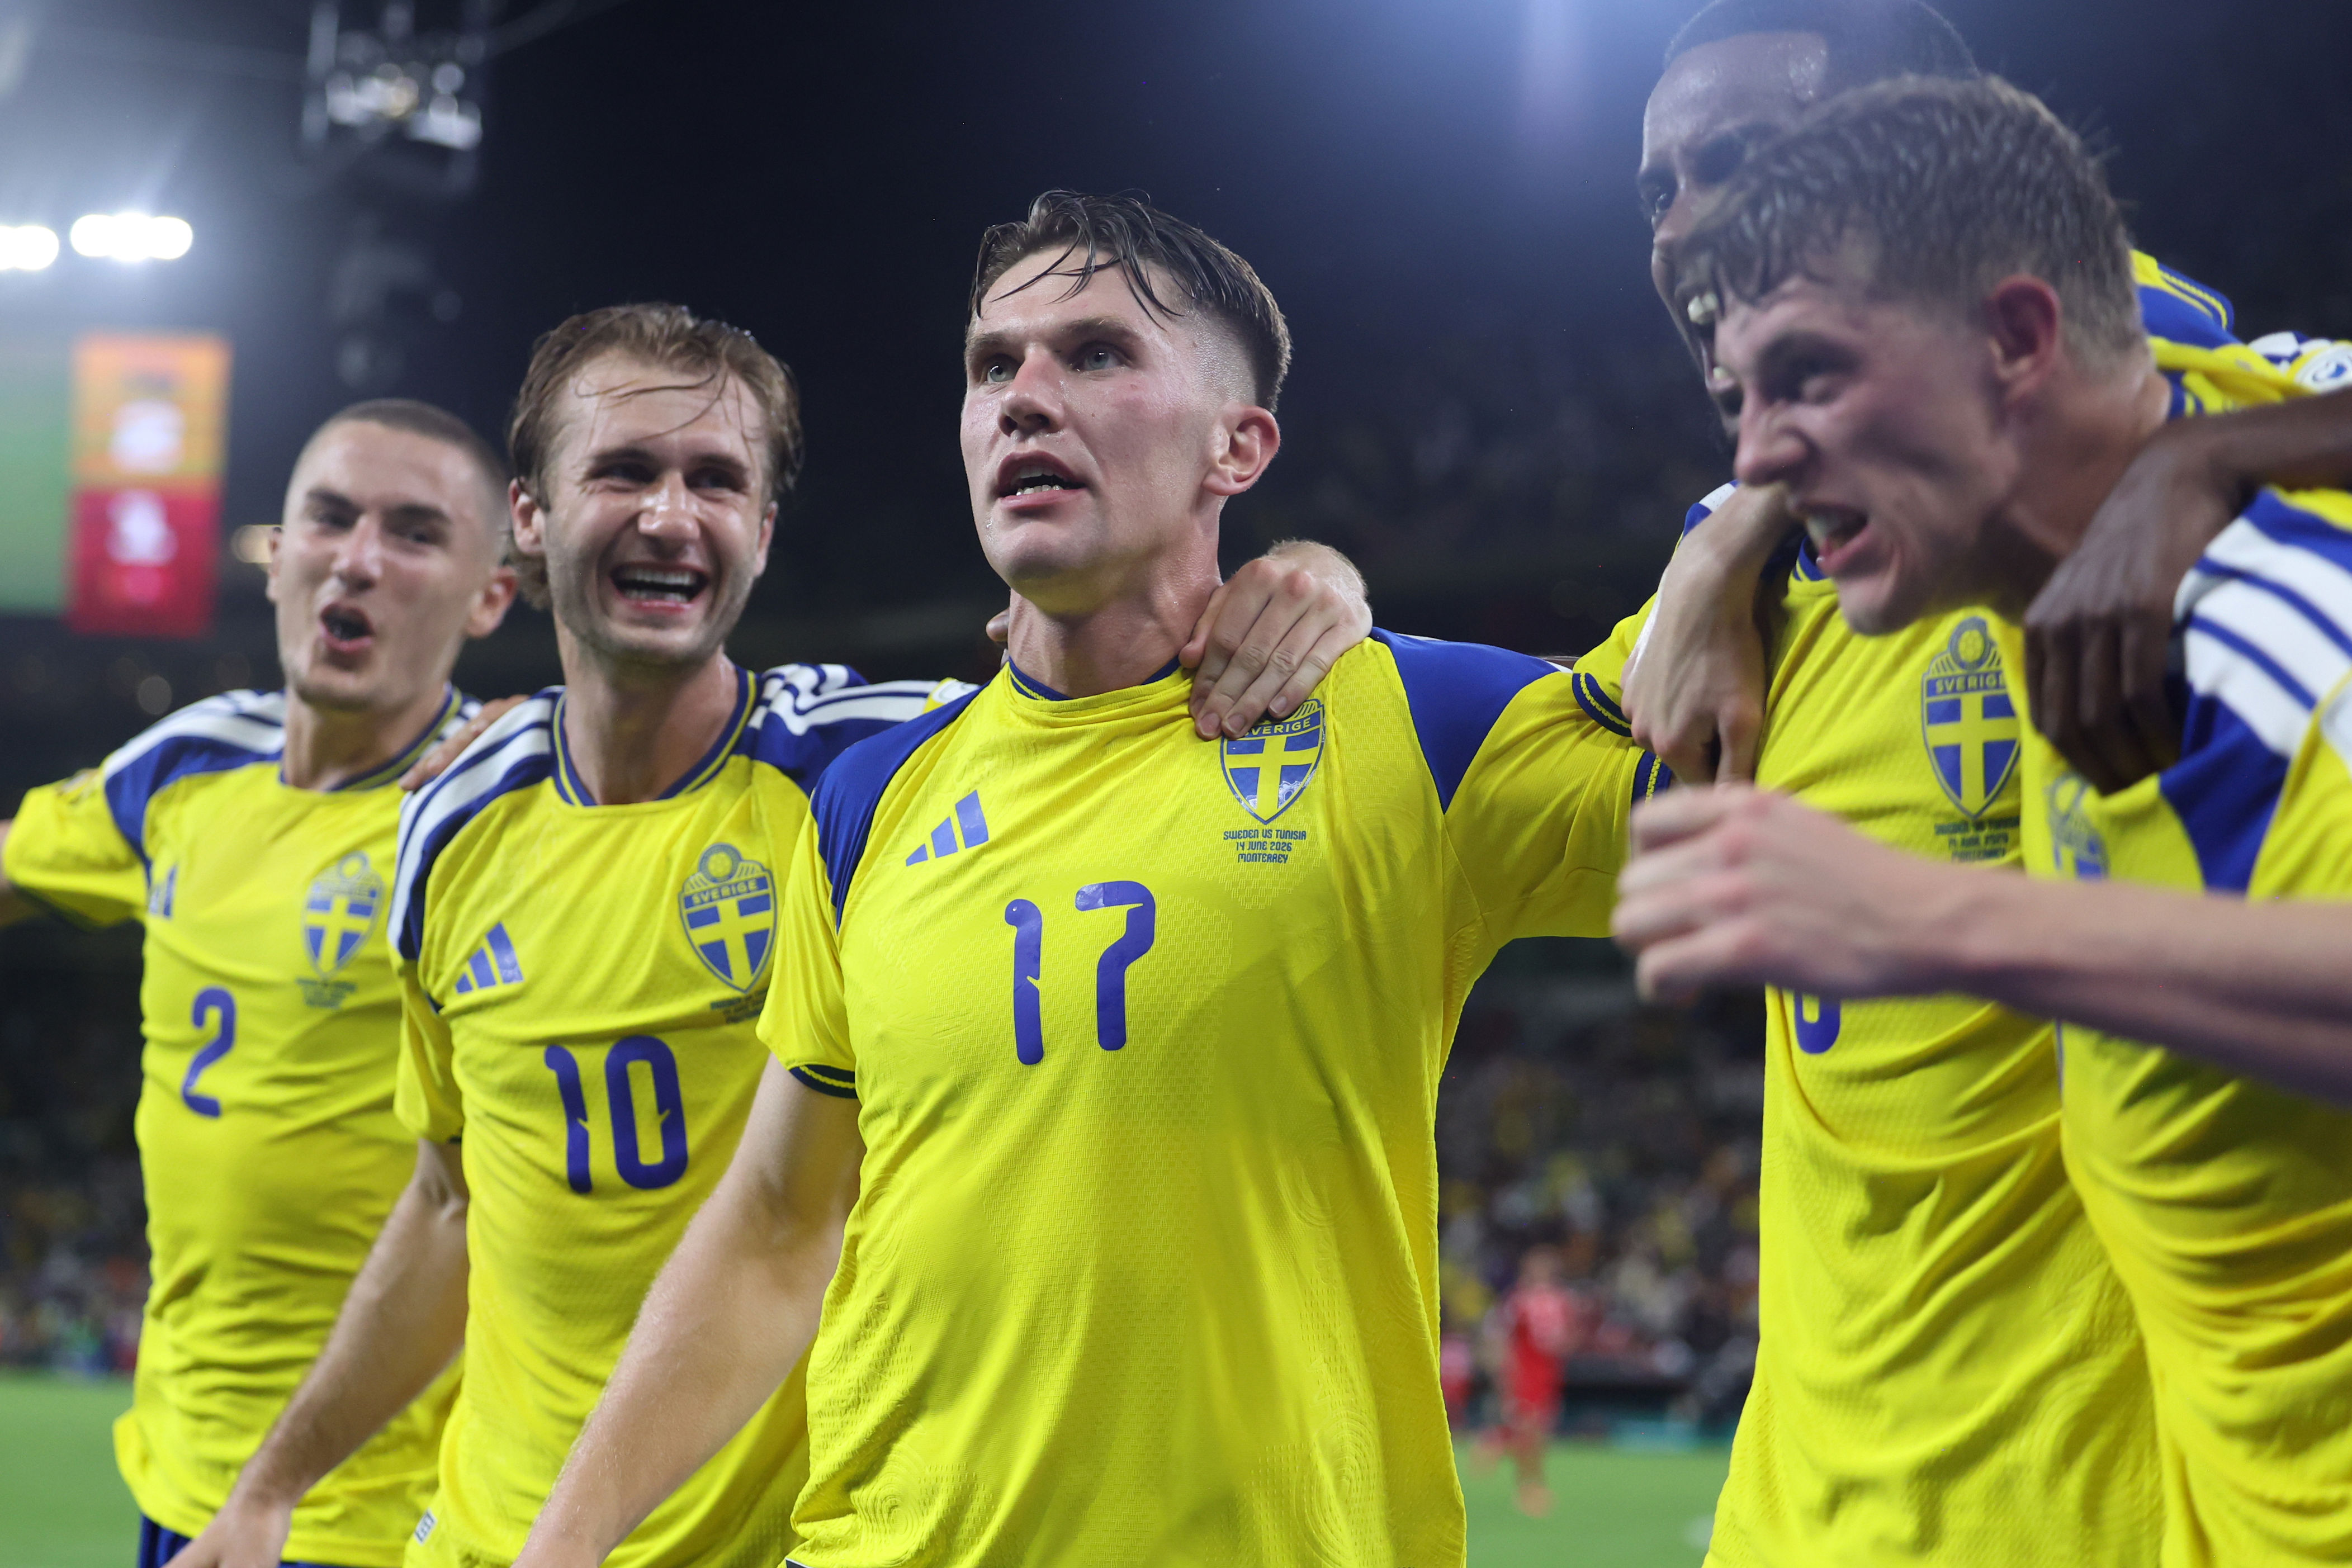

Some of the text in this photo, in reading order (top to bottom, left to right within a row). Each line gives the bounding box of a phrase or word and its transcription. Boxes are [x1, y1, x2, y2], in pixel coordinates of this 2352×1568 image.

[1244, 717, 1311, 736] VERIGE
[1224, 830, 1259, 840] SWEDEN
[1275, 830, 1307, 840] TUNISIA
[1237, 841, 1293, 851] 14 JUNE 2026
[1238, 853, 1289, 864] MONTERREY
[692, 878, 759, 905] SVERIGE
[1005, 880, 1156, 1065] 17
[181, 986, 236, 1118] 2
[544, 1035, 688, 1194] 10
